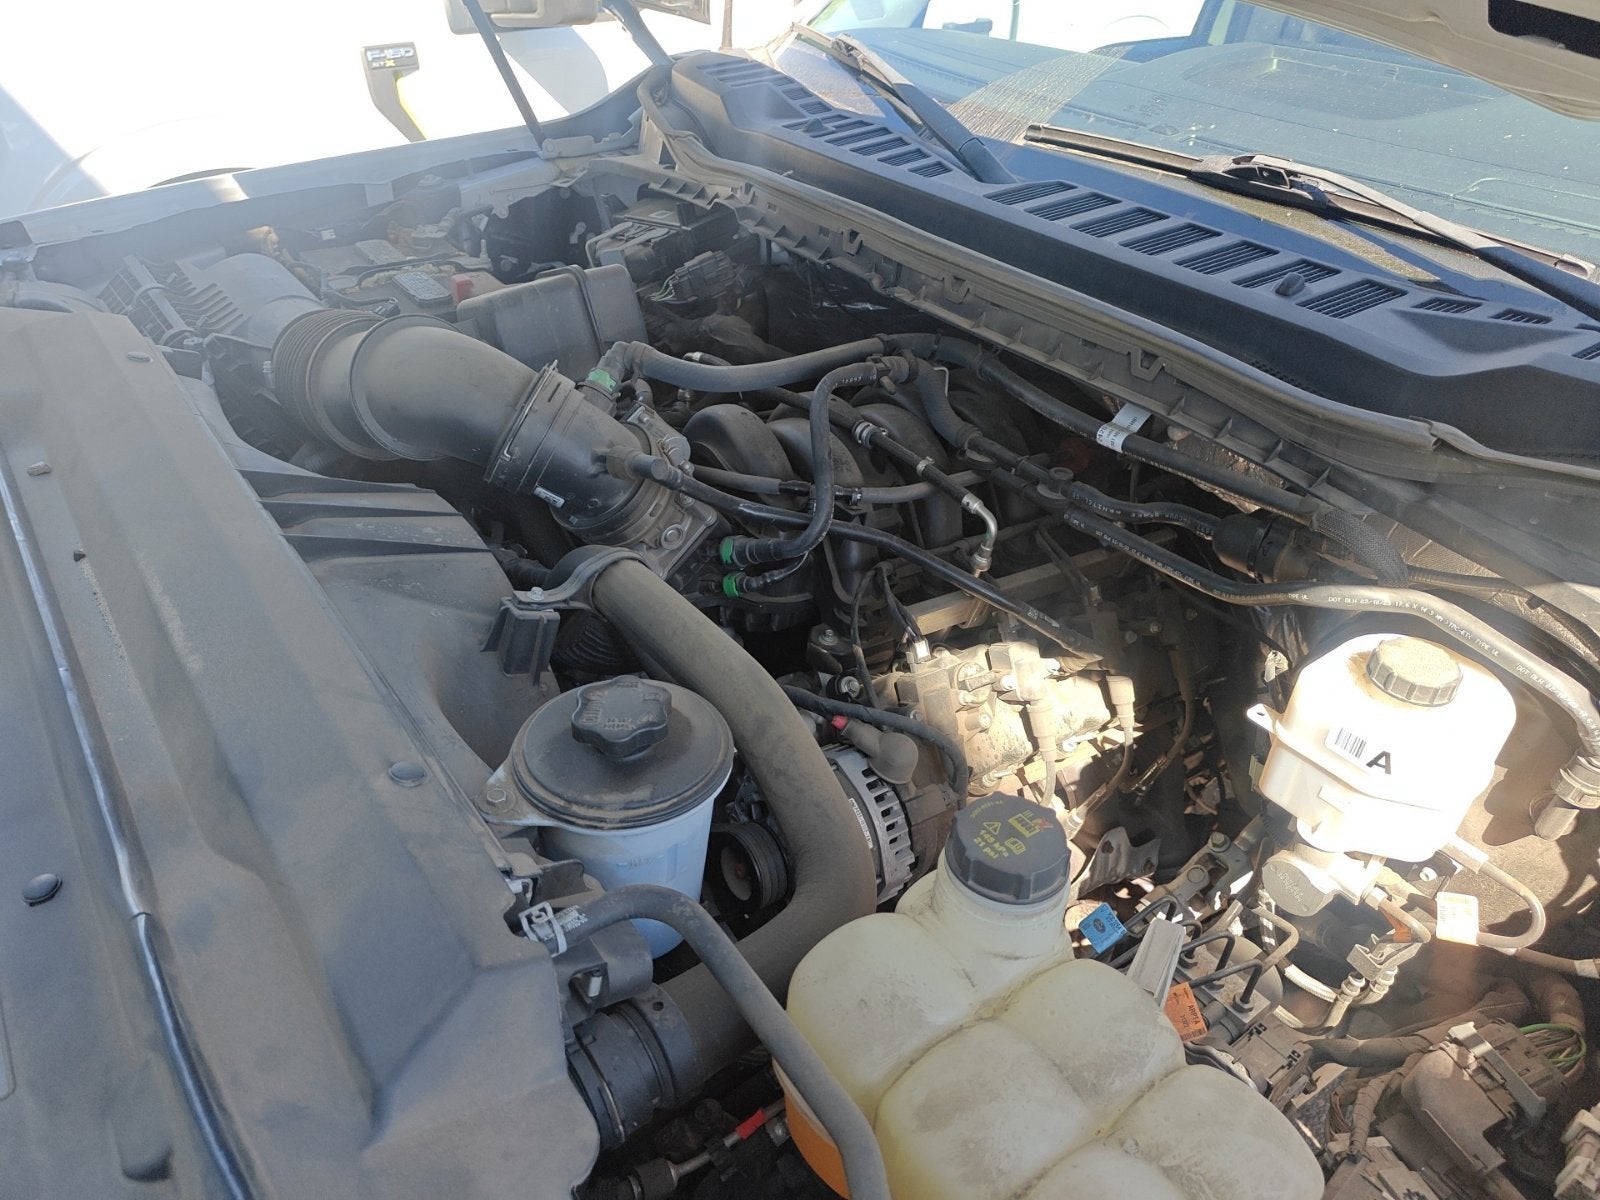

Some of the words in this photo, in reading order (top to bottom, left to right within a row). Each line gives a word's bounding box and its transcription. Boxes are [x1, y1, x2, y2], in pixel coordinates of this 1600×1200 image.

[367, 47, 414, 61] F-150
[1474, 638, 1491, 650] TYPE
[1516, 664, 1530, 675] DOT
[1366, 750, 1391, 774] A
[983, 847, 999, 859] psi
[993, 842, 1009, 857] kPa
